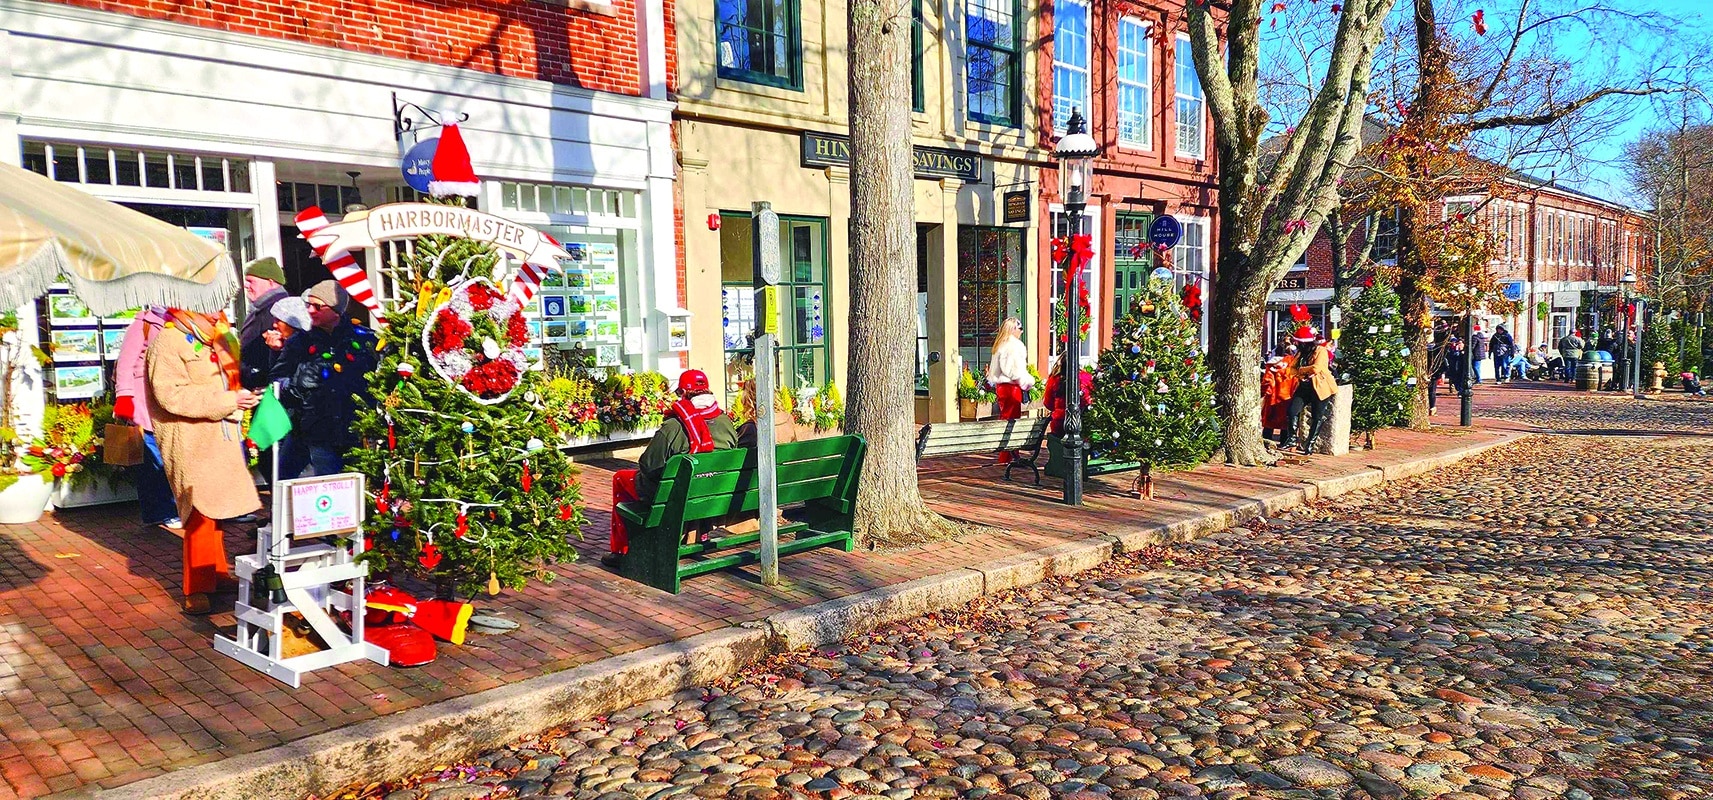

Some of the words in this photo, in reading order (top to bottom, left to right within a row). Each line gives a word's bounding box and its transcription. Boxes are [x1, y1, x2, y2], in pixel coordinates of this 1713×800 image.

[913, 151, 972, 172] SAVINGS
[380, 210, 525, 245] HARBORMASTER
[1277, 279, 1301, 288] RS.
[294, 485, 318, 496] HAPPY
[322, 480, 353, 491] STROLL!
